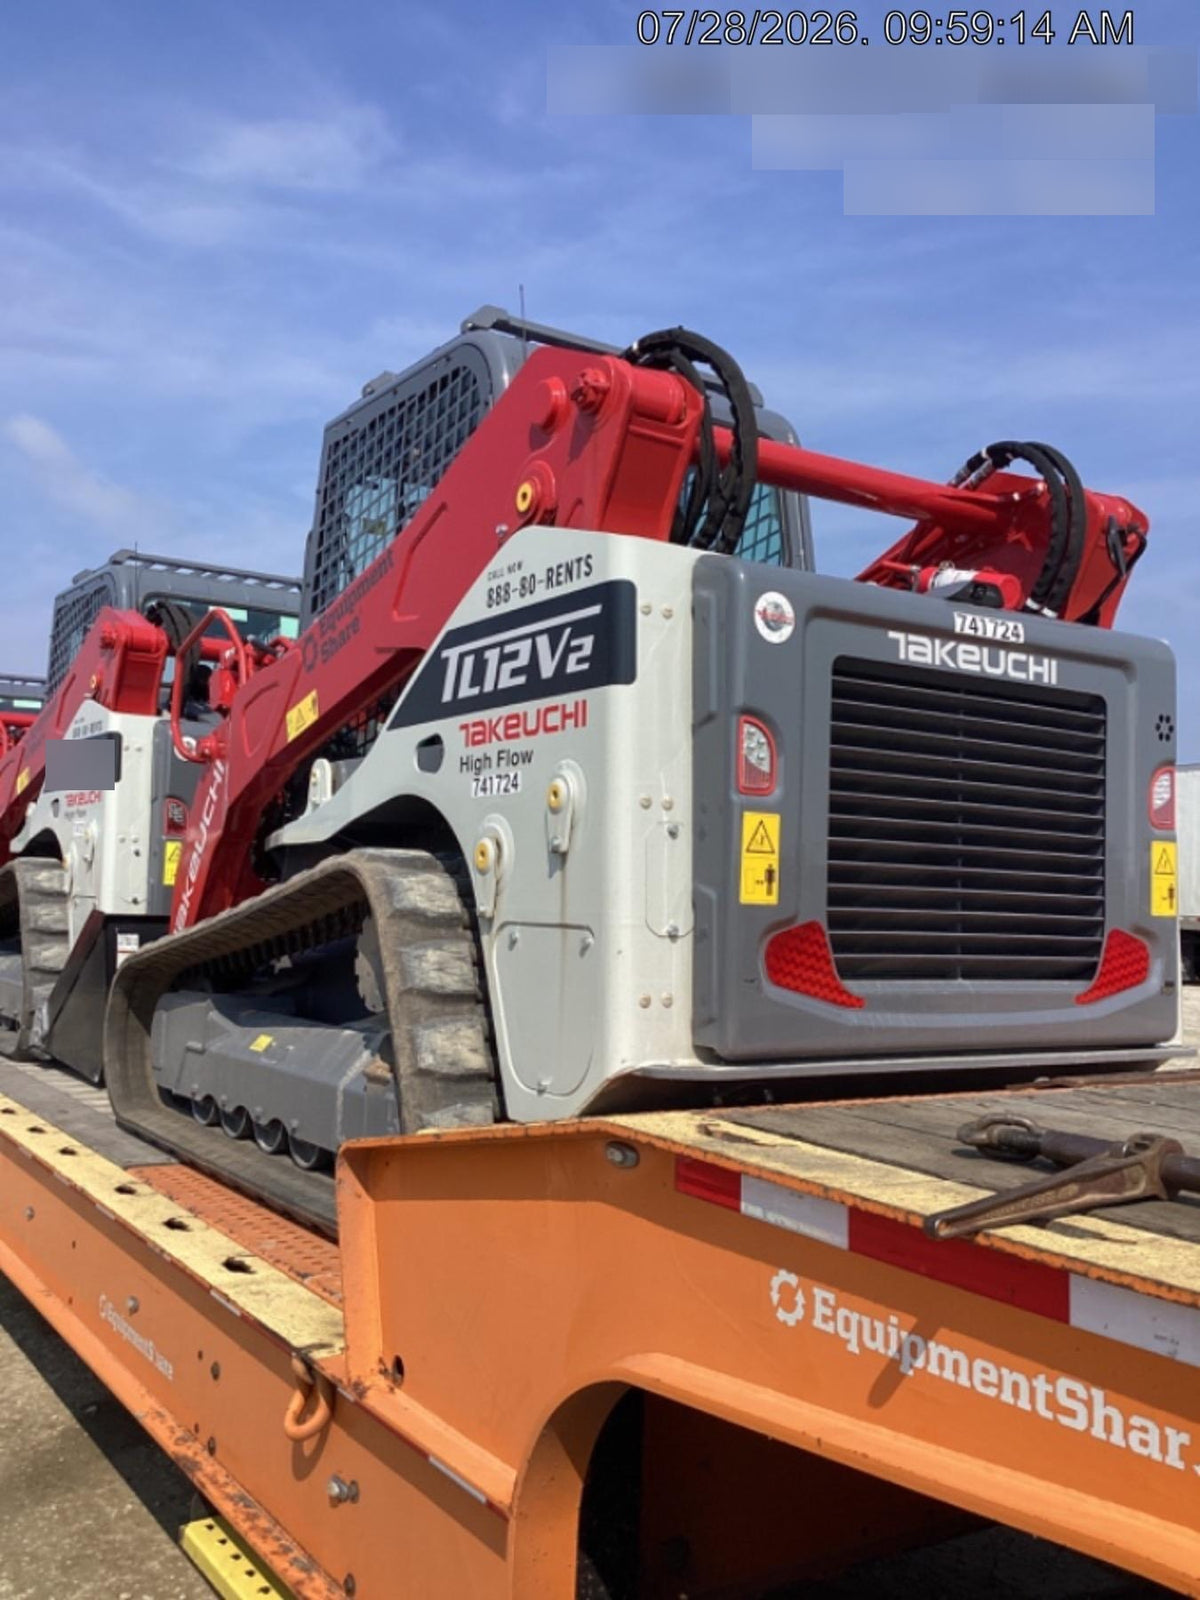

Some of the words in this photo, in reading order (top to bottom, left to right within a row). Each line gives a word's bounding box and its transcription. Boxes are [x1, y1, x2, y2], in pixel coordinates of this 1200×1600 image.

[486, 553, 594, 609] 888-80-RENTS
[957, 613, 1021, 643] 741724
[887, 630, 1059, 685] TAKEUCHI
[459, 699, 588, 748] TAKEUCHI
[460, 752, 492, 775] High
[497, 749, 534, 768] Flow
[473, 771, 520, 797] 741724
[812, 1286, 1200, 1476] EquipmentShar
